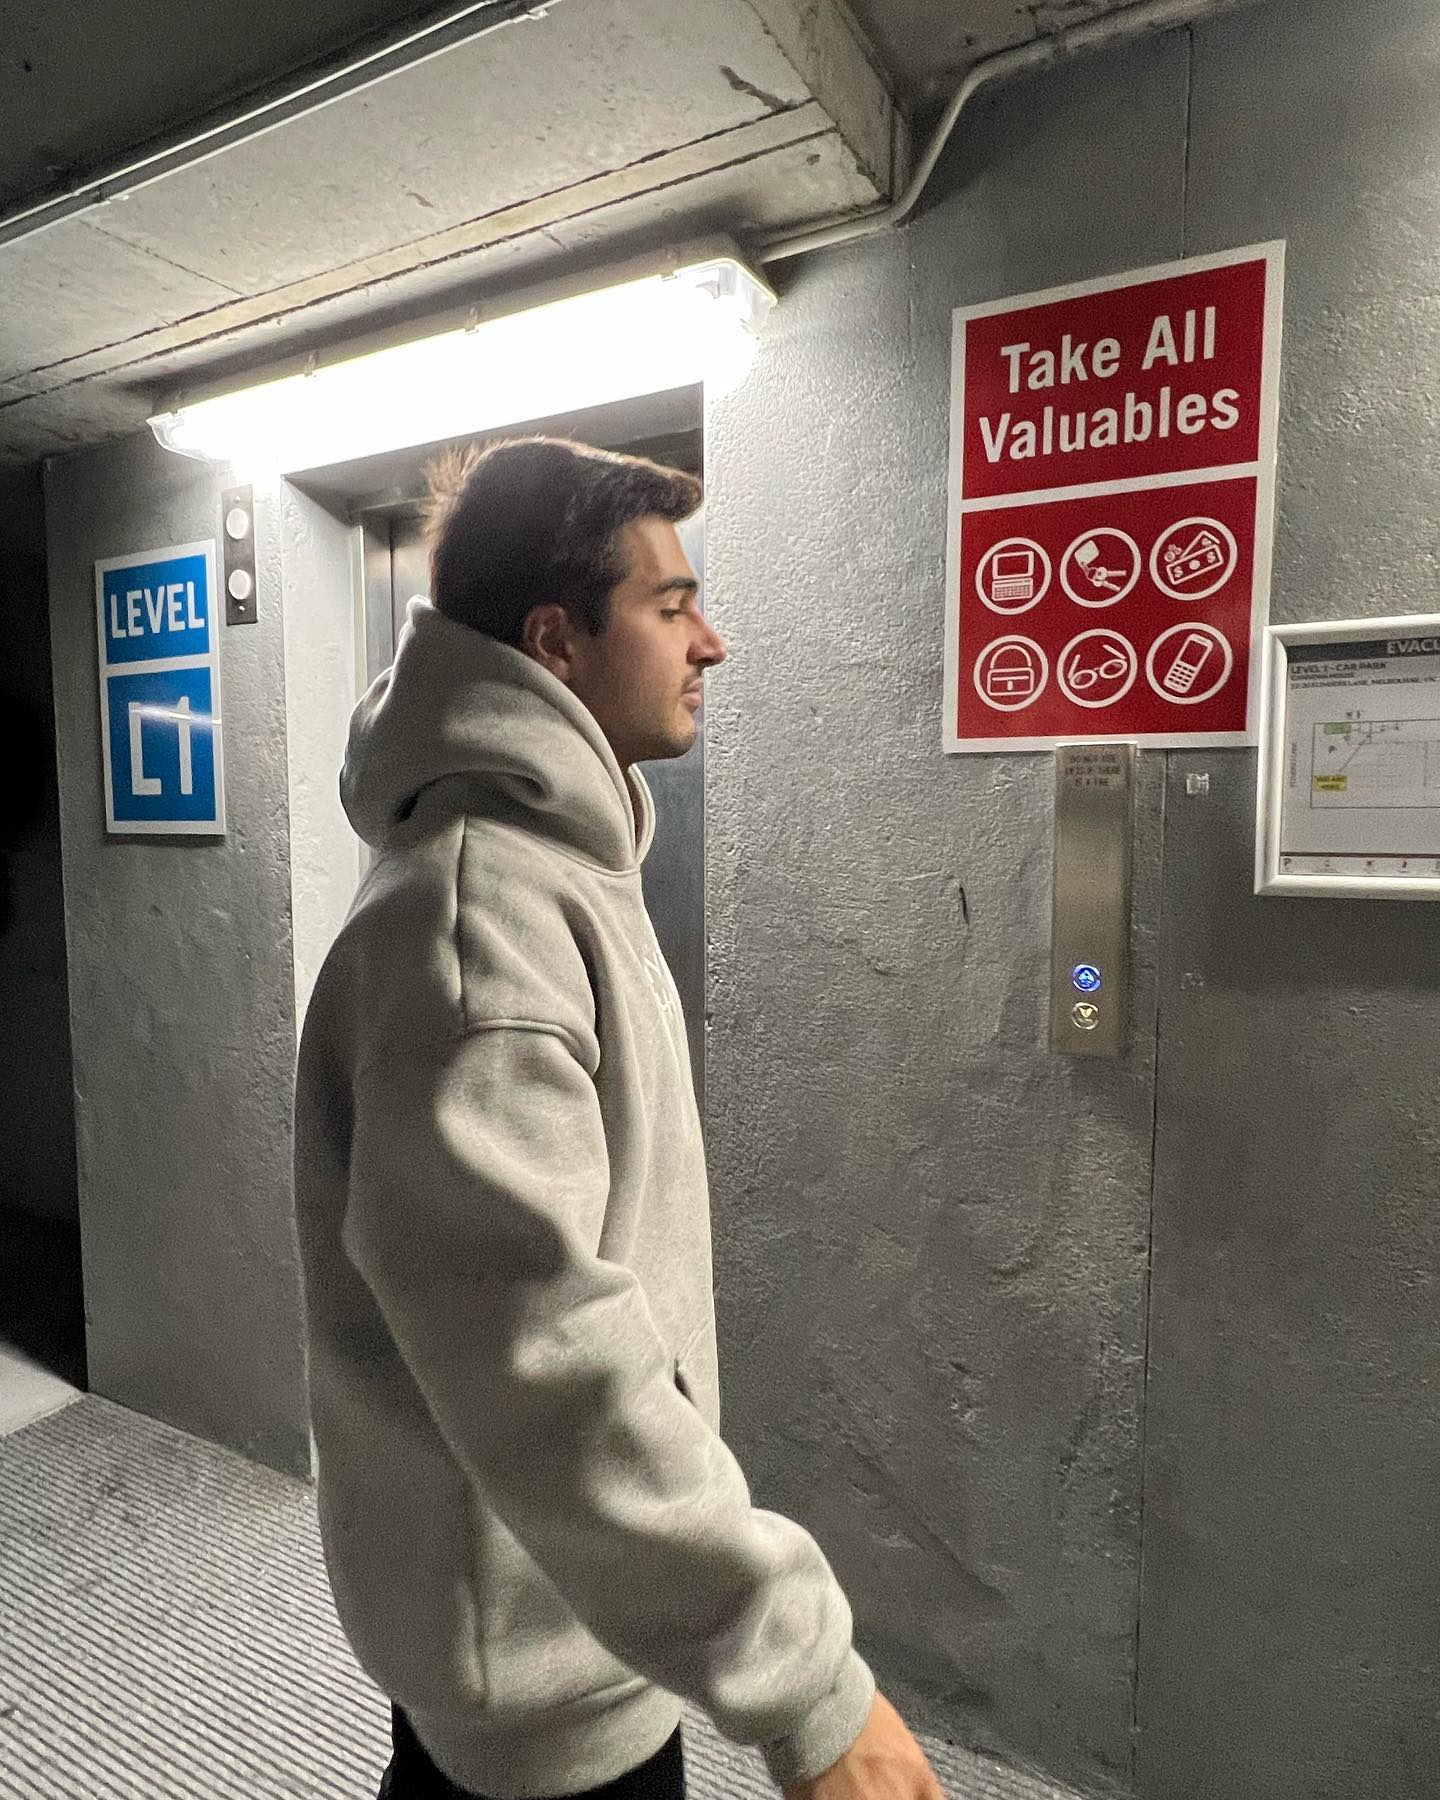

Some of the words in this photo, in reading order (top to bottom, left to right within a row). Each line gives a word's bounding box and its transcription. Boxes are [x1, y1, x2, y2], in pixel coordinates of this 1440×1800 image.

[1001, 334, 1121, 394] Take
[1141, 306, 1216, 371] All
[978, 386, 1240, 464] Valuables
[110, 581, 205, 639] LEVEL
[1336, 663, 1357, 671] CAR
[1359, 662, 1386, 670] PARK
[128, 696, 193, 796] L1
